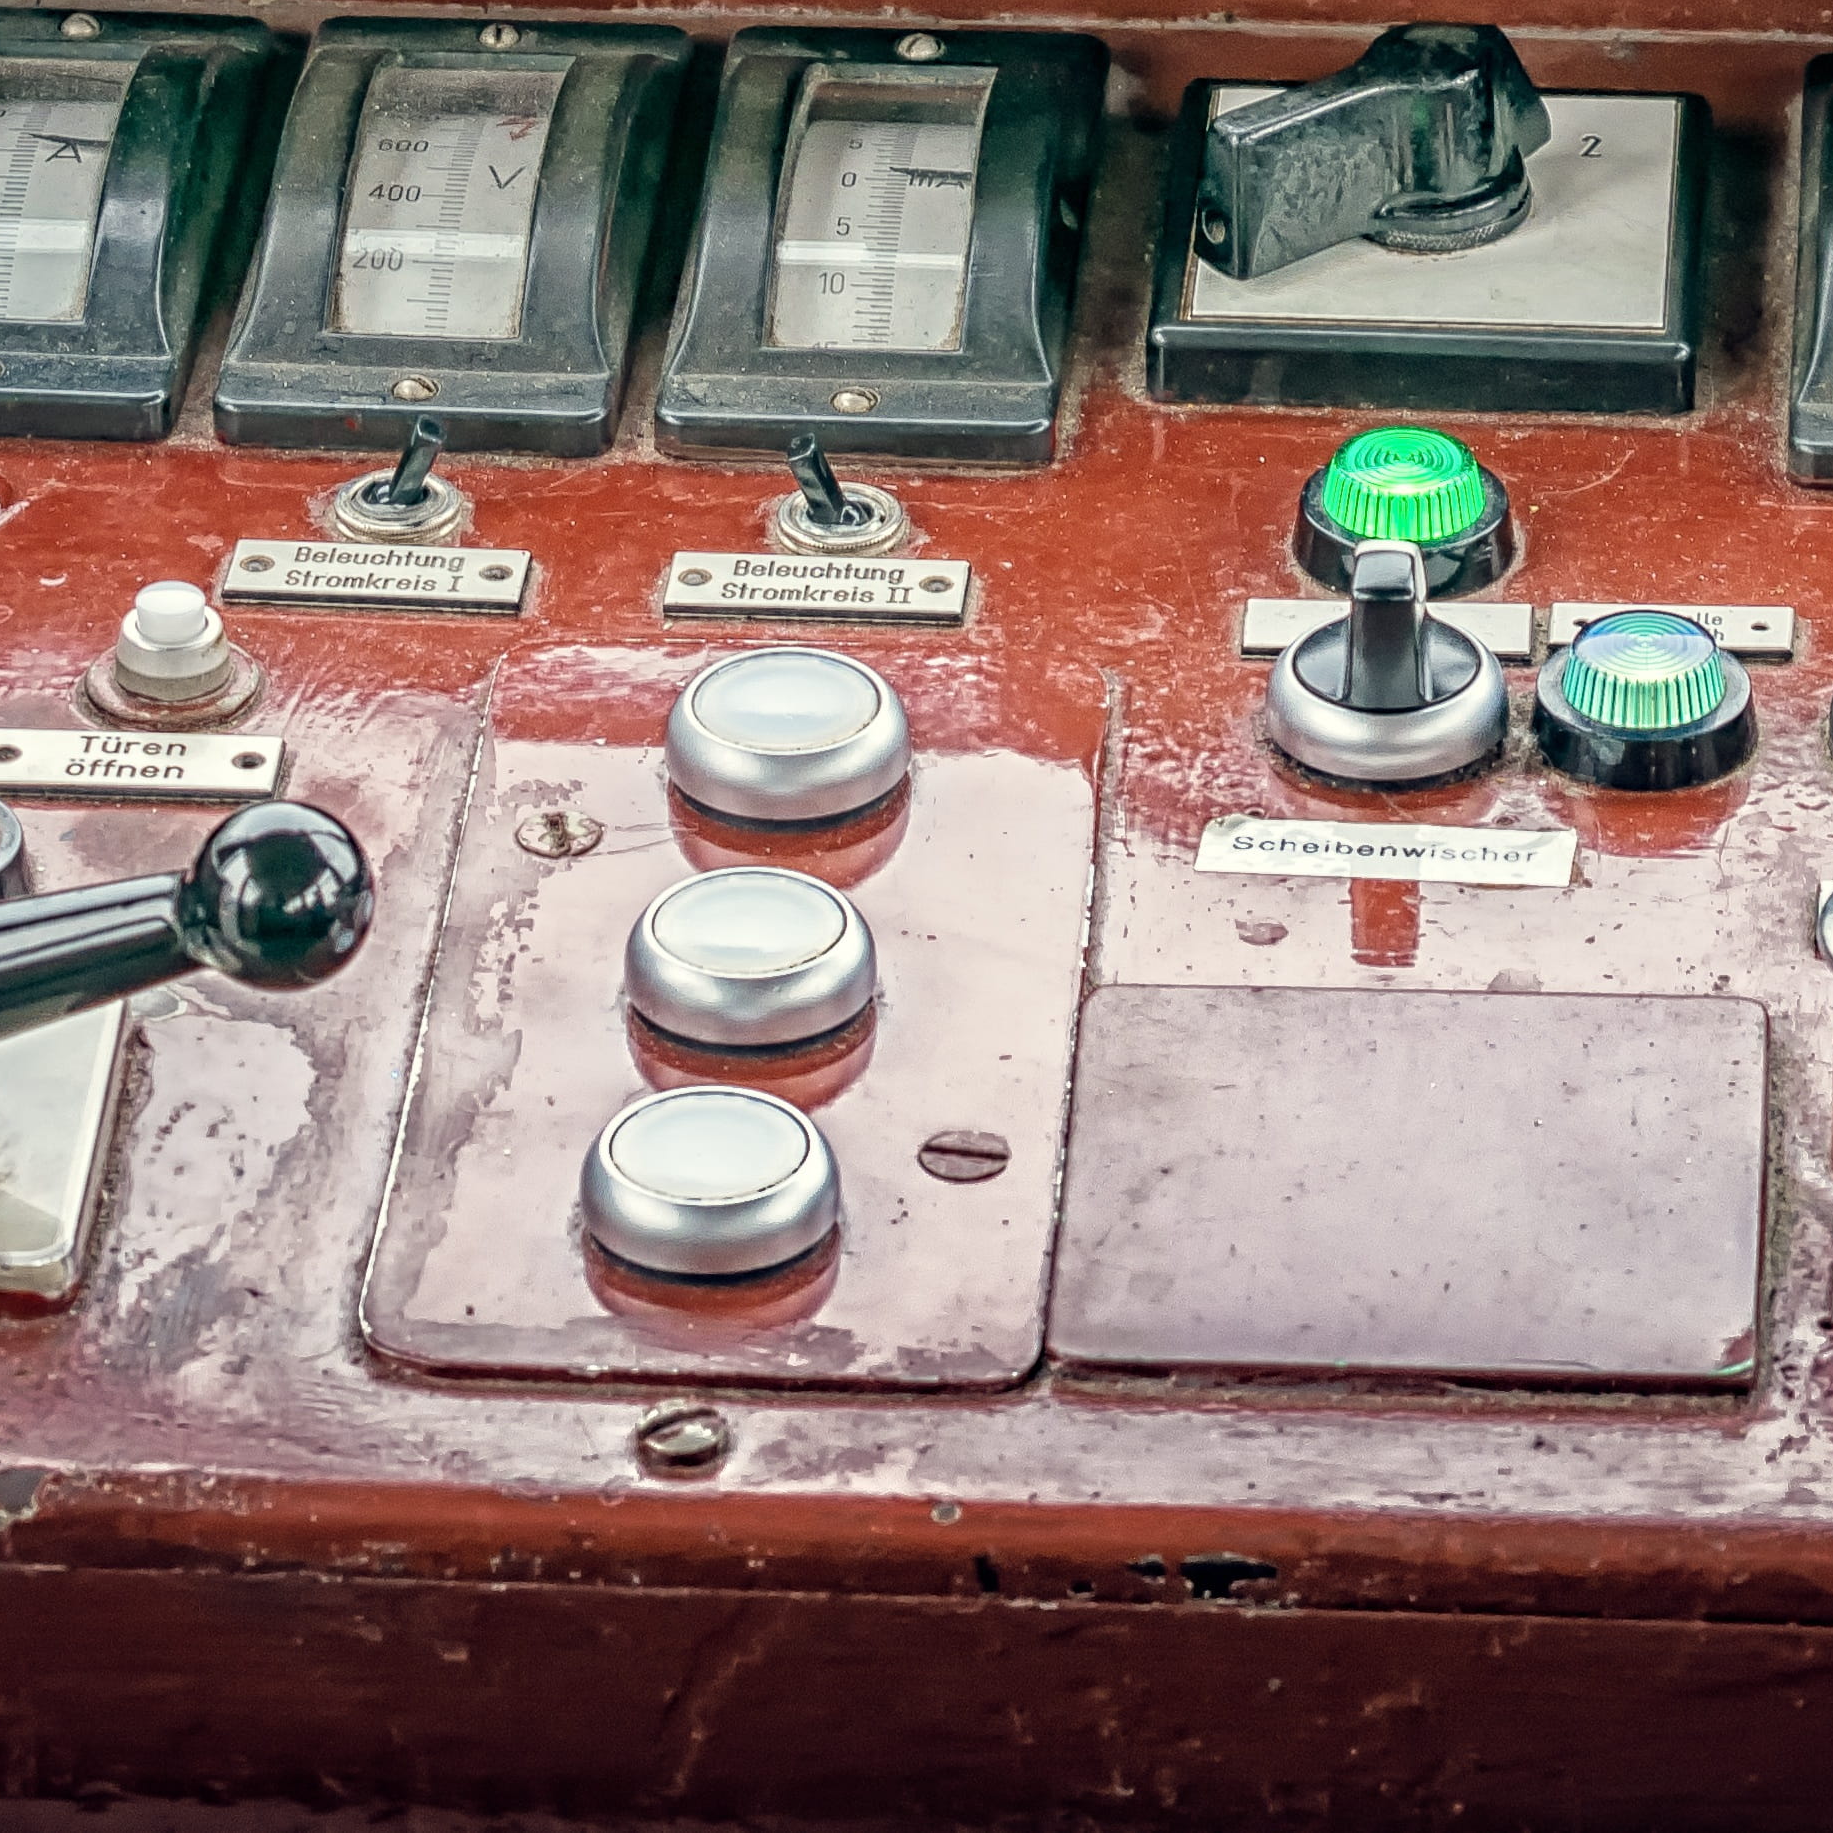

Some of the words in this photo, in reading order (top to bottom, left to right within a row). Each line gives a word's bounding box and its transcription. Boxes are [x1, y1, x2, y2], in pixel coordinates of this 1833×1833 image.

[44, 143, 82, 164] A
[377, 138, 429, 153] 600
[849, 138, 864, 150] 5
[1580, 134, 1603, 158] 2
[488, 164, 527, 189] V
[840, 171, 857, 188] 0
[368, 183, 422, 203] 400
[835, 216, 852, 237] 5
[352, 247, 405, 272] 200
[817, 271, 846, 295] 10
[294, 546, 466, 572] Beleuchtung
[284, 569, 438, 592] Stromkreis
[447, 575, 464, 593] I
[733, 559, 906, 584] Beleuchtung
[720, 582, 875, 603] Stromkreis
[884, 586, 914, 604] II
[79, 735, 188, 756] Türen
[64, 758, 185, 779] öffnen
[1232, 835, 1540, 864] Scheibenwischer
